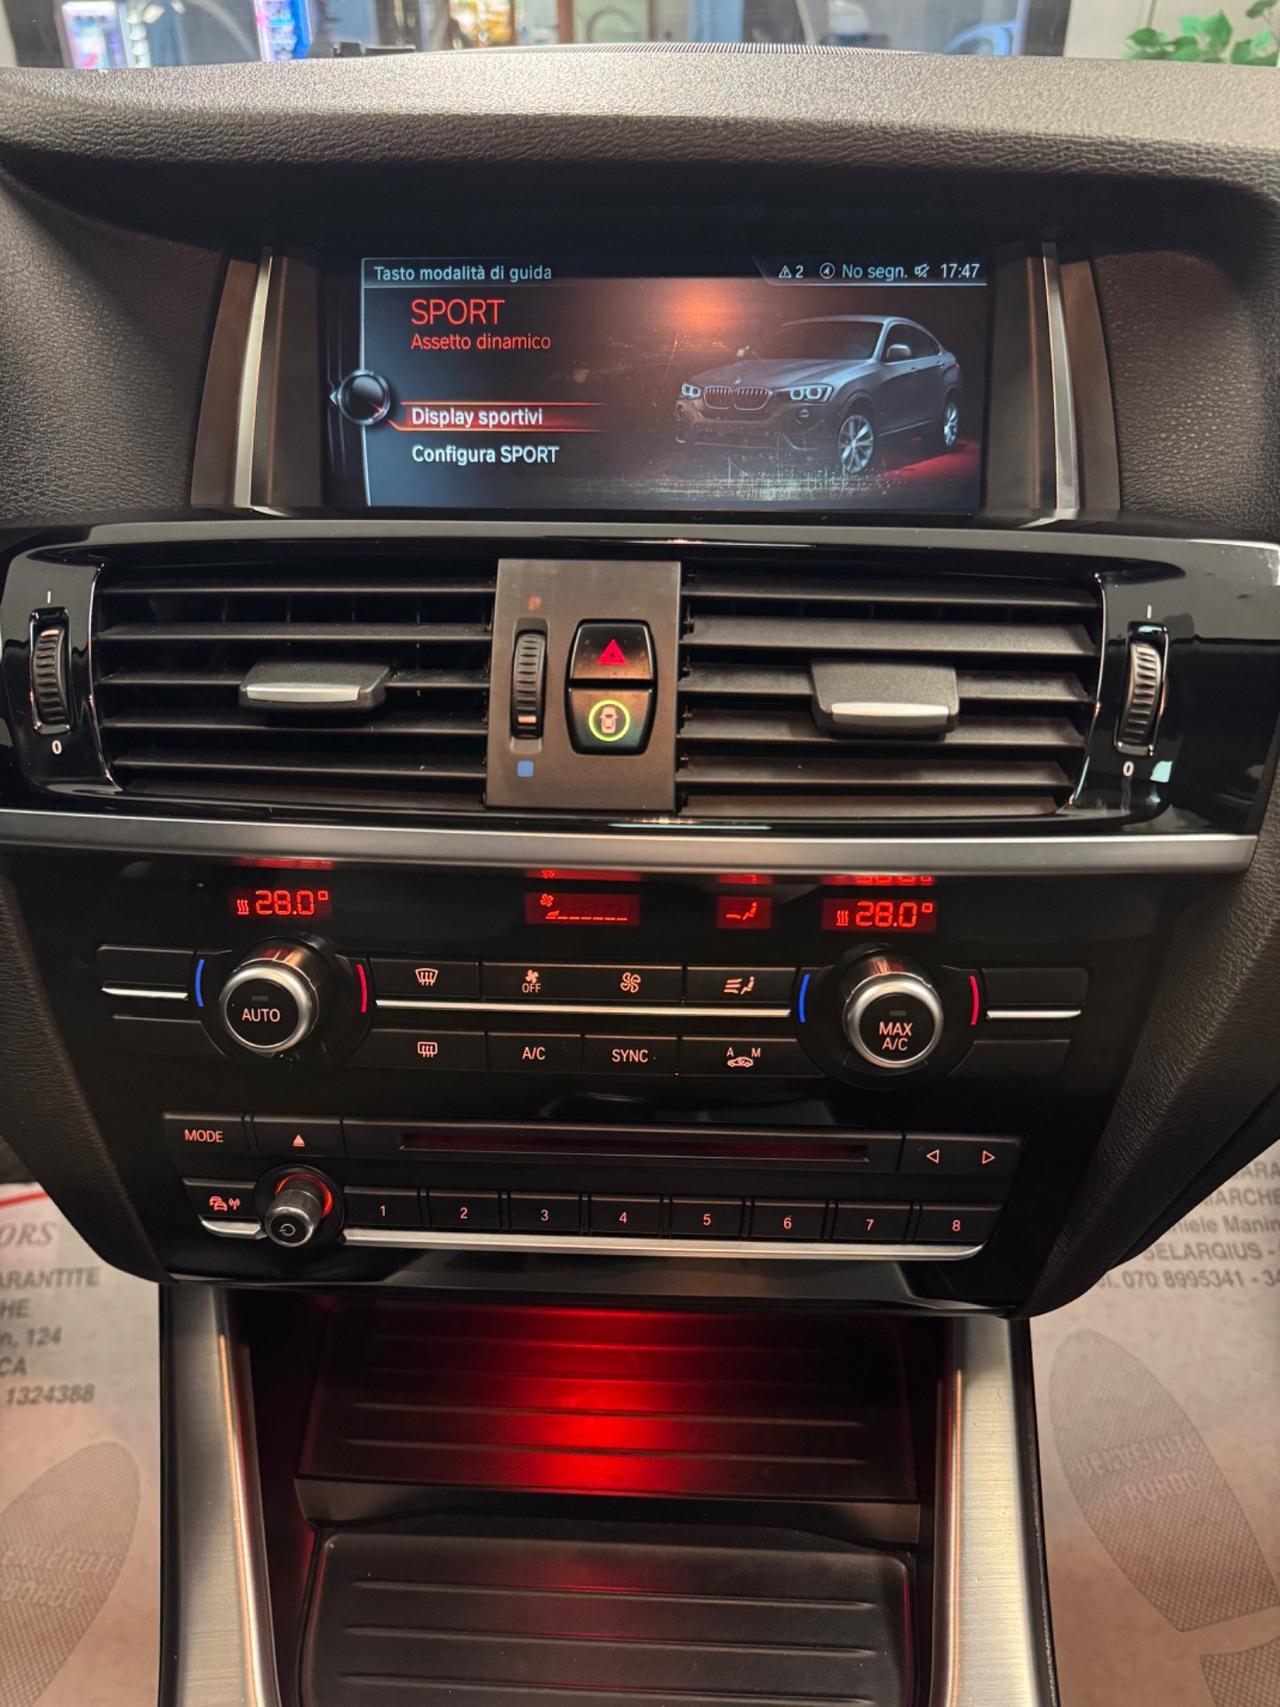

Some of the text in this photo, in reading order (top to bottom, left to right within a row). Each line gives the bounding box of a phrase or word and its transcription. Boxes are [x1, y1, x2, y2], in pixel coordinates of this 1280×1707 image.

[374, 264, 552, 284] Tasto modalità di guida
[795, 264, 804, 279] 2
[842, 264, 908, 282] No segn.
[940, 263, 981, 279] 17:47
[410, 298, 505, 326] SPORT
[410, 333, 551, 350] Assetto dinamico
[411, 407, 543, 429] Display sportivi
[411, 445, 560, 467] Configura SPORT
[521, 982, 542, 993] OFF
[241, 1007, 281, 1023] AUTO
[878, 1020, 913, 1037] MAX
[881, 1036, 908, 1051] A/C
[521, 1046, 546, 1061] A/C
[611, 1049, 649, 1063] SYNC
[726, 1047, 761, 1058] A M
[183, 1128, 224, 1144] MODE
[379, 1204, 387, 1217] 1
[459, 1206, 469, 1220] 2
[539, 1208, 550, 1222] 3
[618, 1211, 629, 1224] 4
[702, 1213, 712, 1226] 5
[783, 1217, 793, 1229] 6
[865, 1218, 875, 1231] 7
[951, 1219, 962, 1232] 8
[1121, 1269, 1158, 1289] 070
[1163, 1269, 1244, 1289] 8995341
[26, 1326, 63, 1347] 124
[6, 1382, 96, 1406] 1324388
